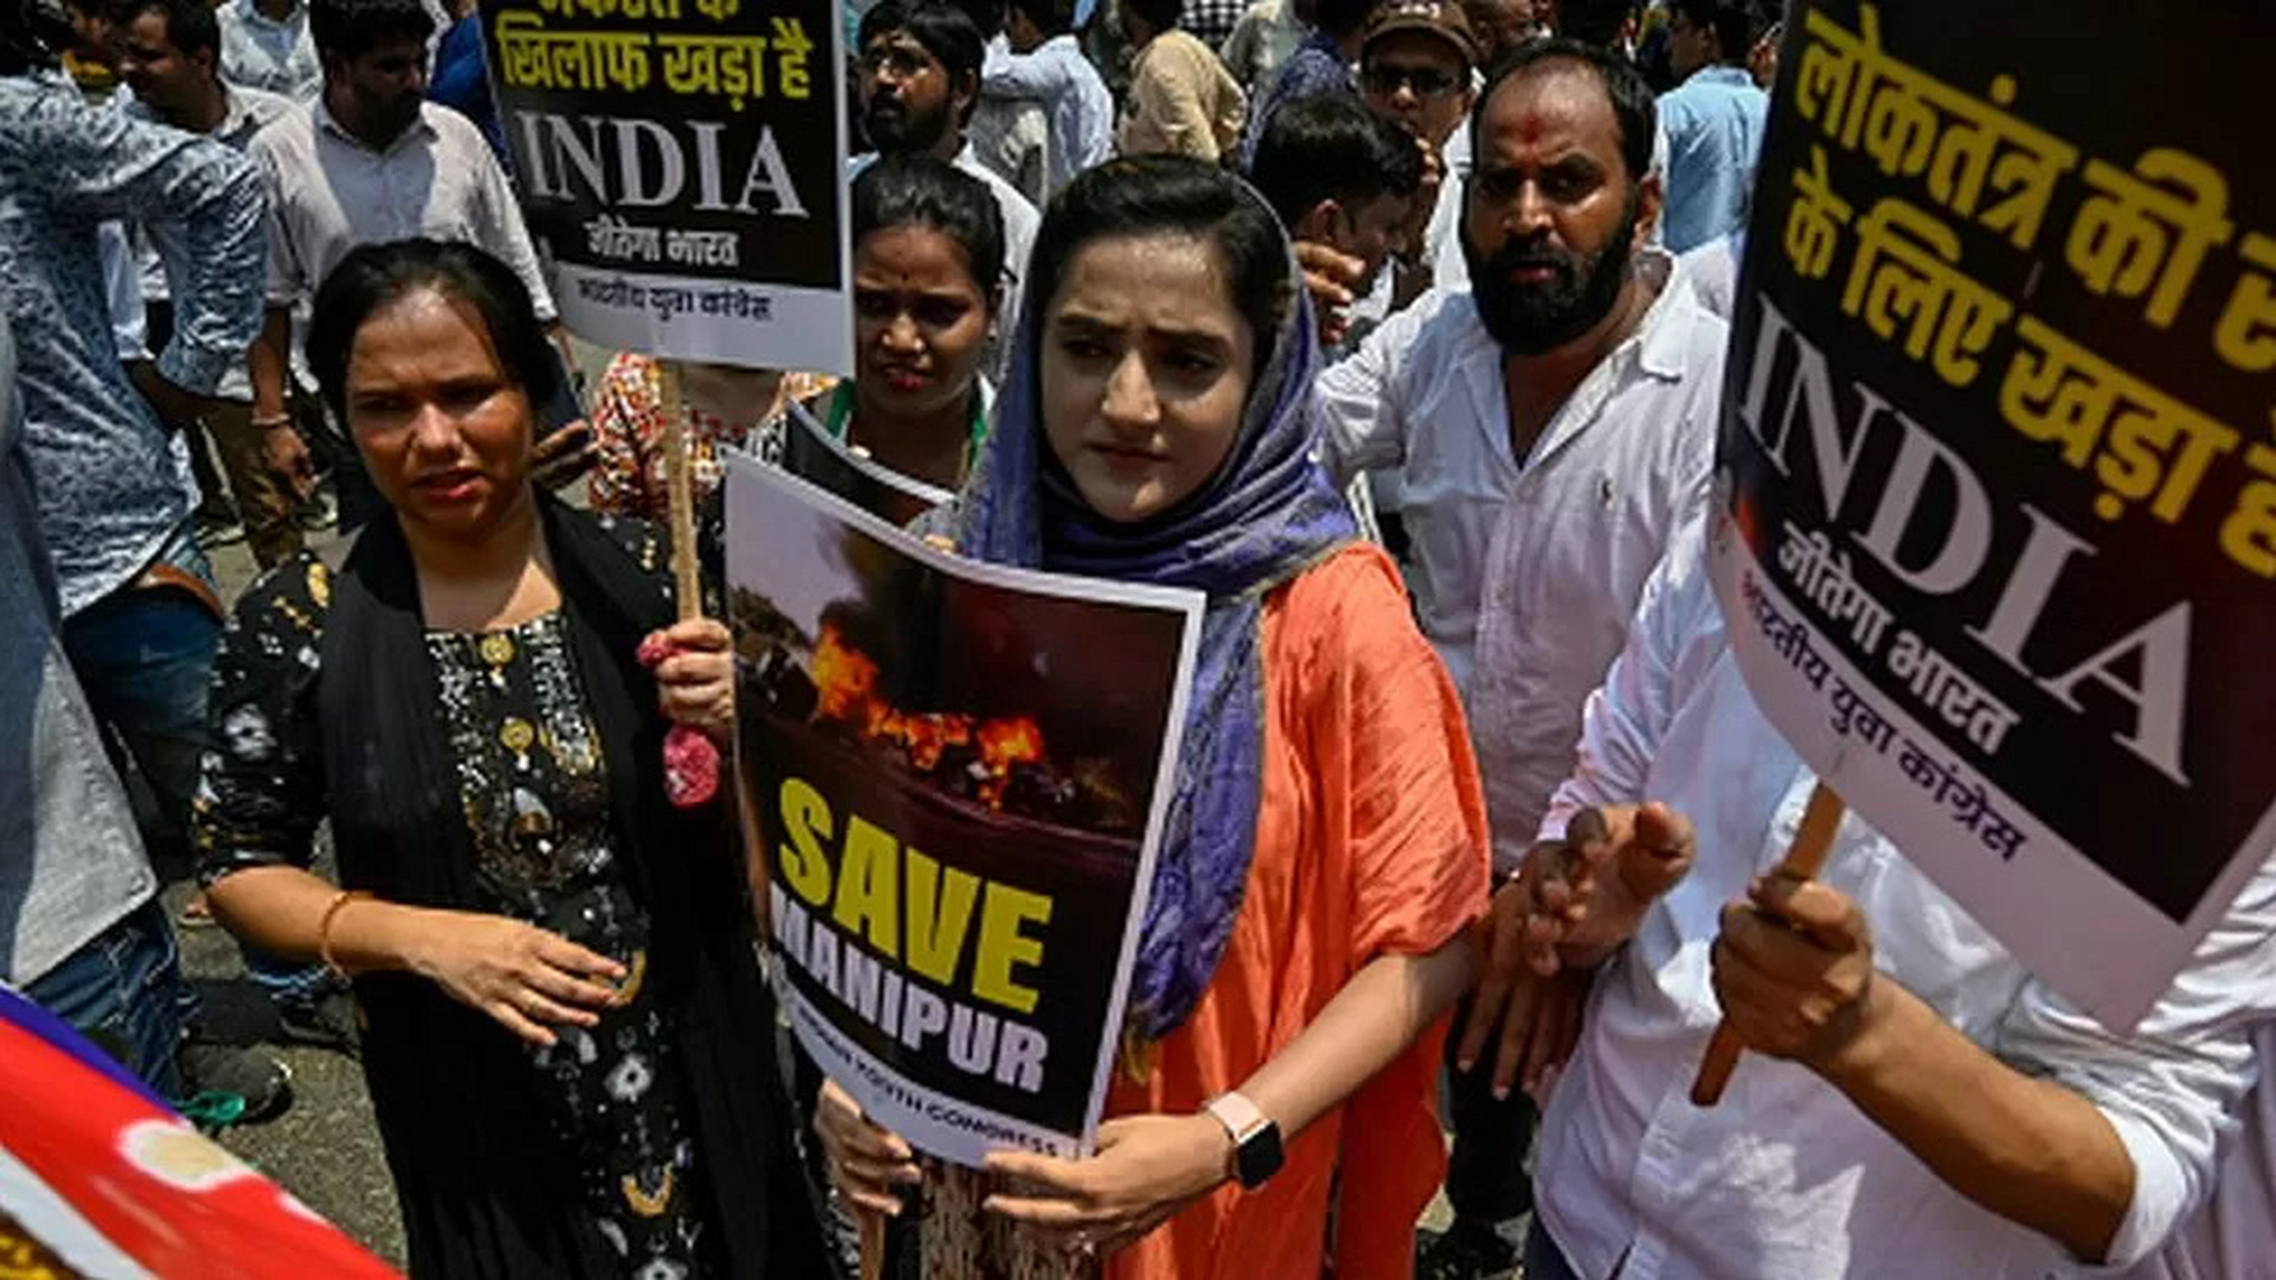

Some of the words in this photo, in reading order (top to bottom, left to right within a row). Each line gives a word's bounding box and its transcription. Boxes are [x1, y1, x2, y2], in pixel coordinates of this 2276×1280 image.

[496, 10, 650, 93] खिलाफ
[657, 32, 767, 112] खड़ा
[772, 16, 813, 99] है
[515, 109, 811, 220] INDIA
[1796, 2, 2080, 251] लोकतंत्र
[2066, 147, 2234, 330] की
[665, 228, 740, 267] भारत
[1783, 143, 1853, 280] के
[1840, 201, 2014, 389] लिए
[1999, 314, 2240, 525] खड़ा
[1740, 291, 2193, 787] INDIA
[1778, 520, 1895, 655] जीतेगा
[1888, 630, 2022, 756] भारत
[1830, 675, 1898, 753] युवा
[1899, 738, 2029, 862] कांग्रेस
[770, 880, 1049, 1093] MANIPUR
[779, 777, 1053, 1014] SAVE
[925, 1103, 1058, 1157] CONGRESS
